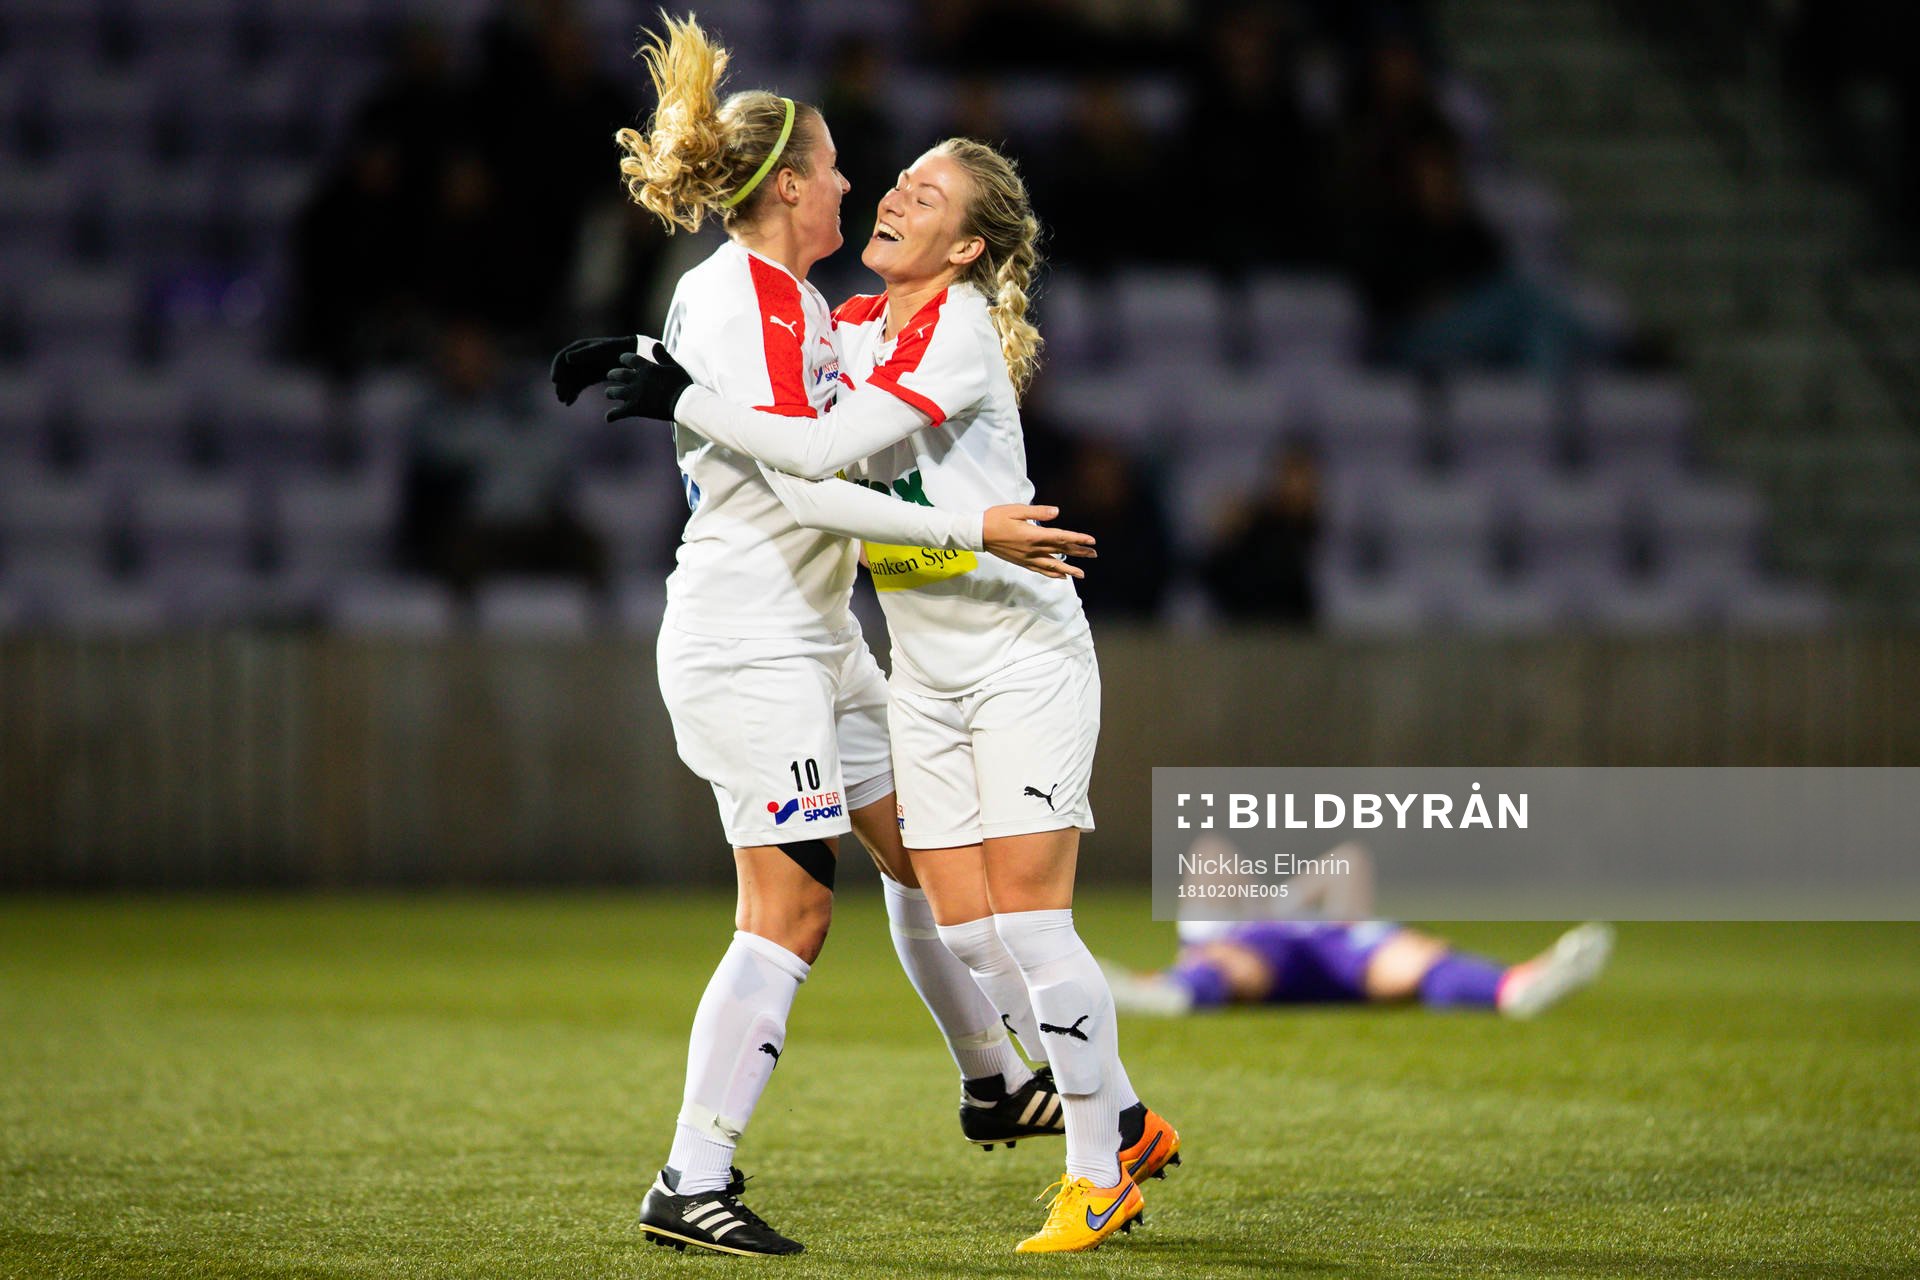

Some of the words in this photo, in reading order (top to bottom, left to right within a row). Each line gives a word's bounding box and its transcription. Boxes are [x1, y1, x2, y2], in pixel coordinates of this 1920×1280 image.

[790, 758, 820, 792] 10
[801, 791, 840, 810] INTER
[804, 804, 843, 822] SPORT
